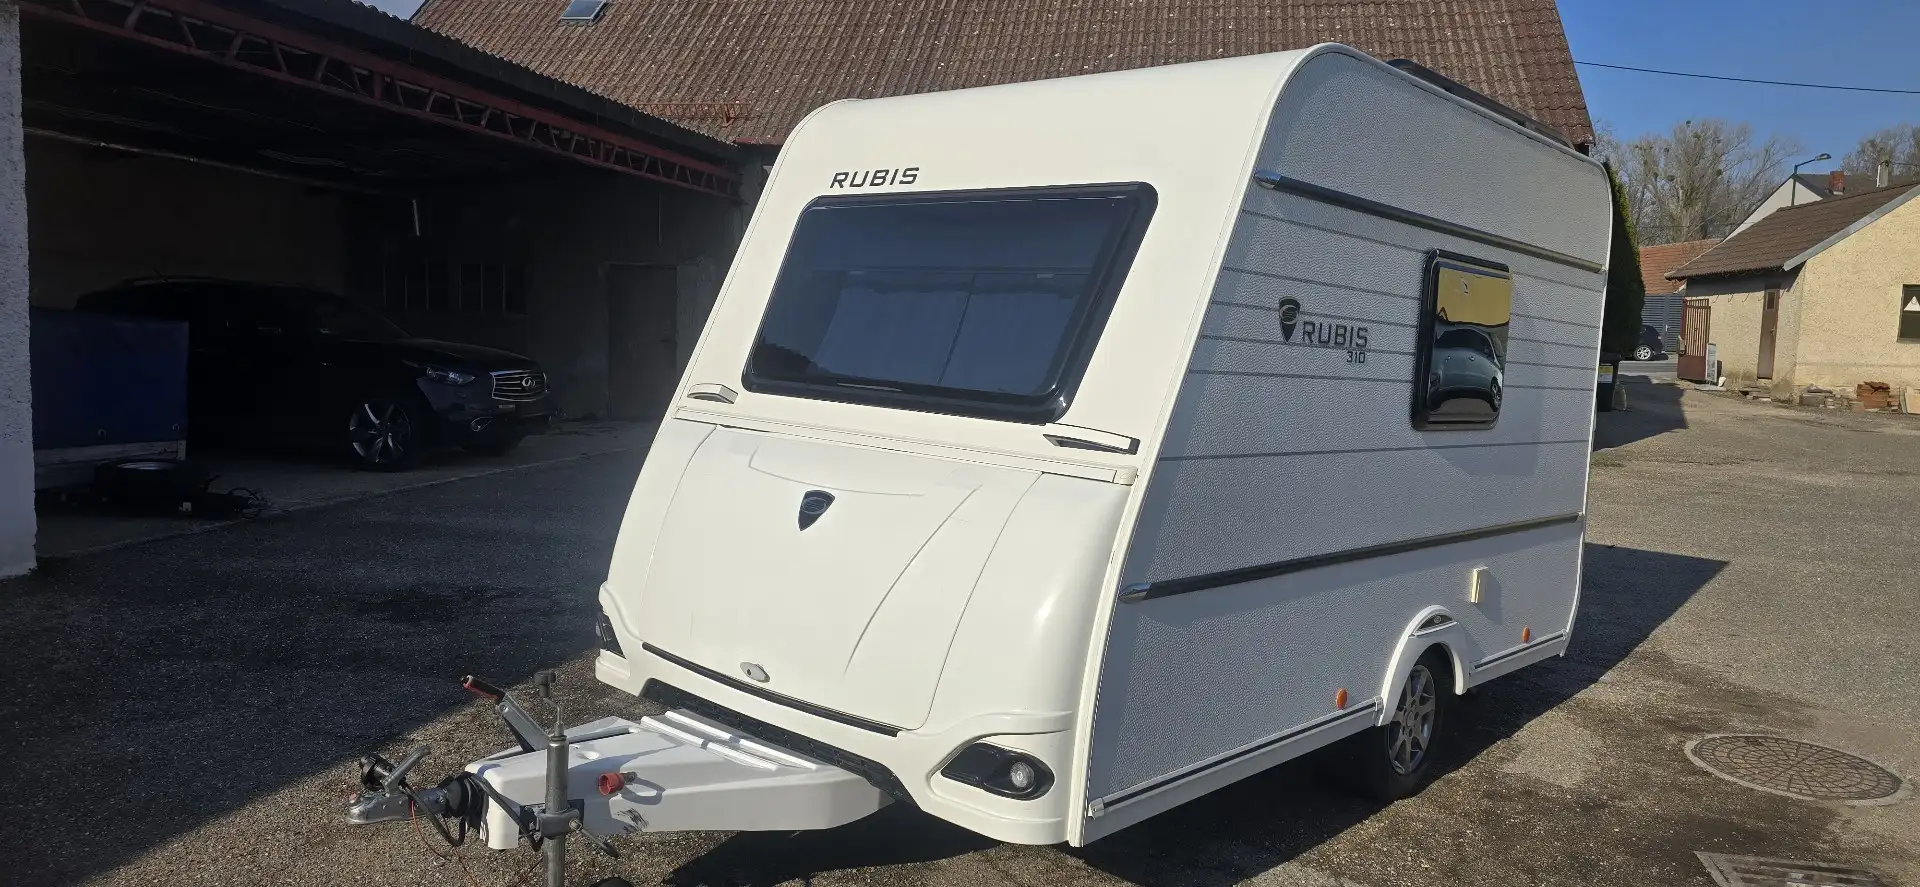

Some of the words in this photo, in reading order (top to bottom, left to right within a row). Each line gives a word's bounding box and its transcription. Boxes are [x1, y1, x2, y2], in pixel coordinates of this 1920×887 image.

[829, 167, 920, 188] RUBIS
[1303, 321, 1368, 347] RUBIS
[1346, 350, 1366, 363] 310
